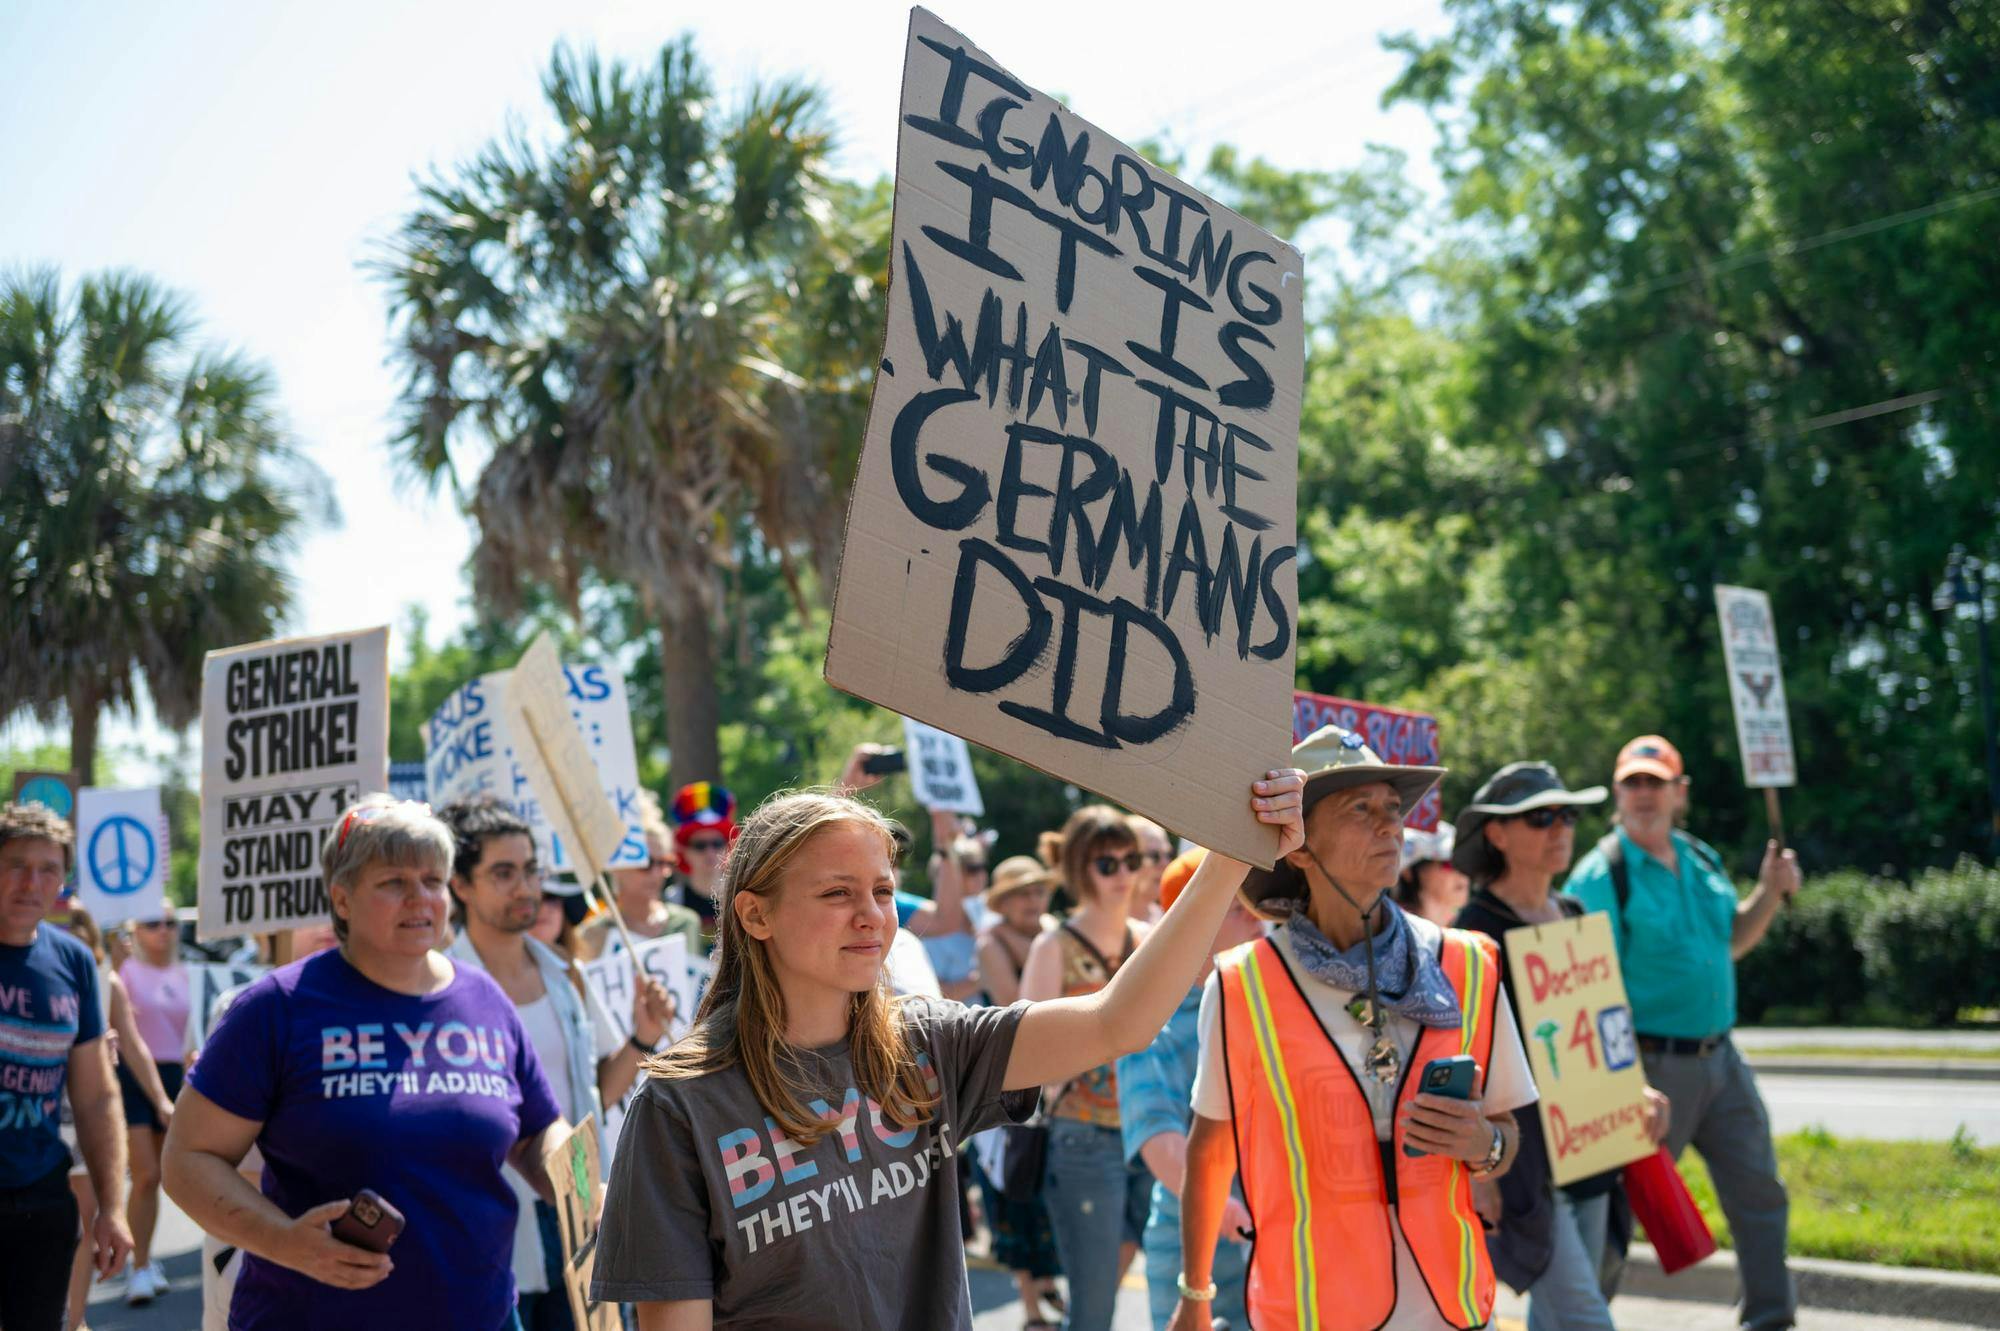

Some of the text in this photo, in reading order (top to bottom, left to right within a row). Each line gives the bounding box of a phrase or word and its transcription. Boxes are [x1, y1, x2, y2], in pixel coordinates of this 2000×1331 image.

[903, 35, 1282, 325] IGNORING
[921, 160, 1276, 410] IT IS
[903, 240, 1277, 530] WHAT THE
[891, 388, 1297, 661] GERMANS
[226, 641, 359, 715] GENERAL
[944, 538, 1196, 749] DID
[225, 701, 358, 782] STRIKE!
[226, 791, 319, 829] MAY
[223, 831, 313, 879] STAND
[222, 875, 331, 924] TO TRUM
[1524, 940, 1611, 1004] Doctors
[322, 1021, 507, 1071] BE YOU
[1569, 1008, 1599, 1069] 4
[426, 1072, 509, 1098] ADJUS
[717, 1116, 819, 1208] BE
